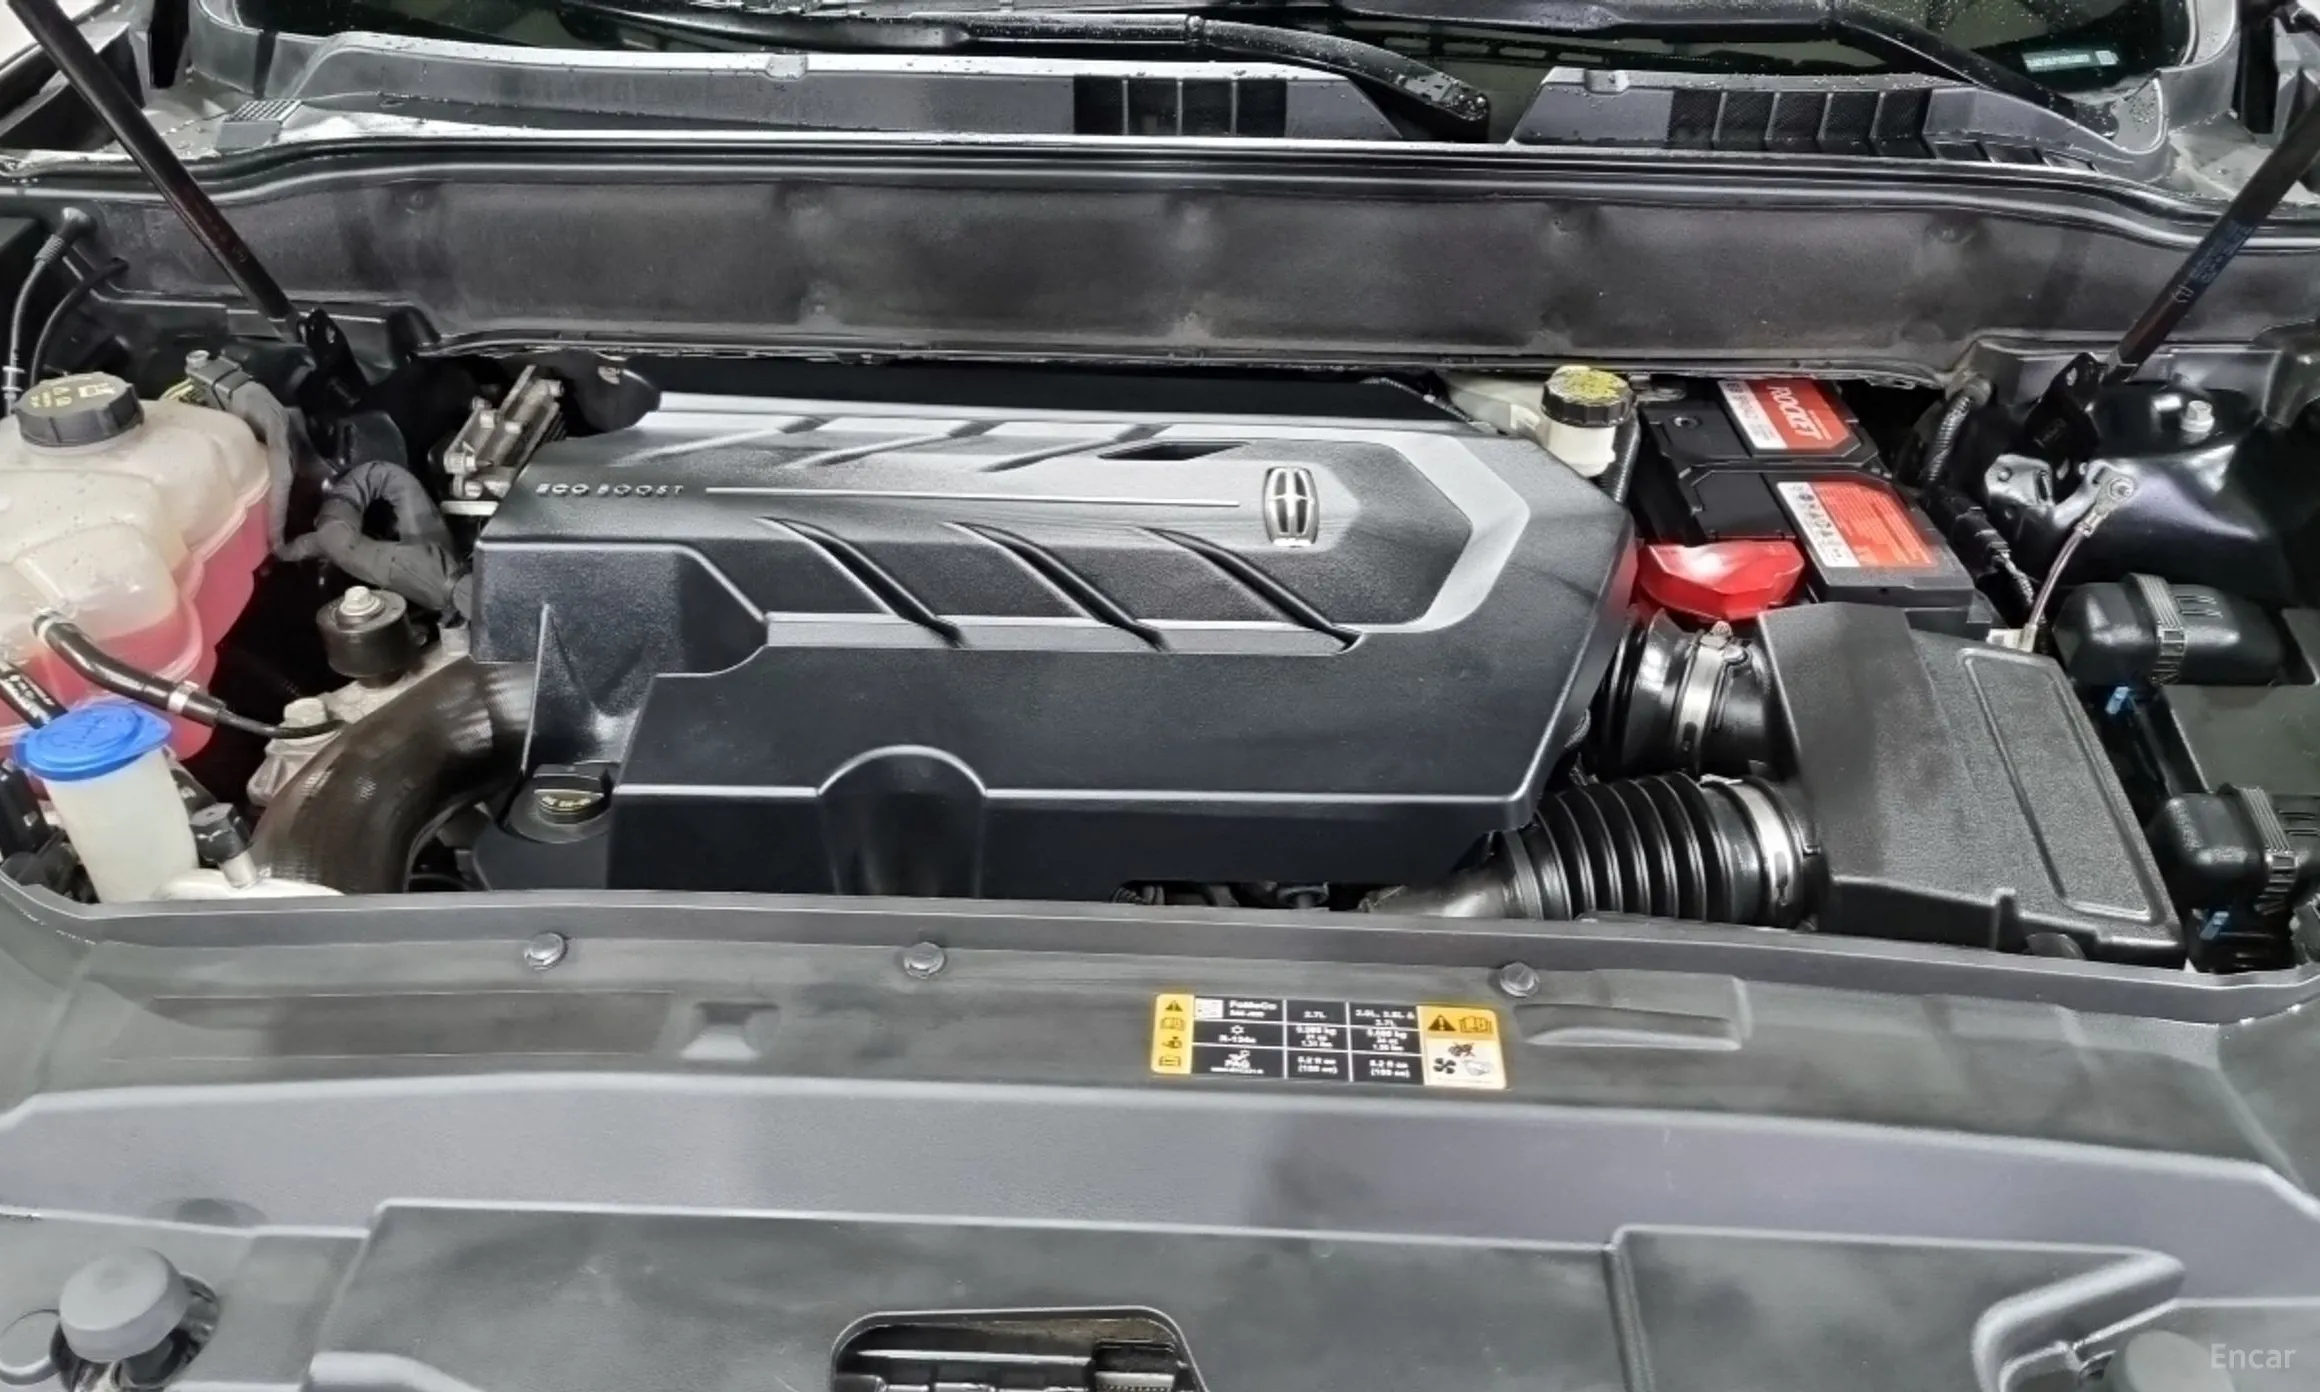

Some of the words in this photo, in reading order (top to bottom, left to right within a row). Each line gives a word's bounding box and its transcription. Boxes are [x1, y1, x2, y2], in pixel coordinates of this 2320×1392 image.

[1766, 385, 1824, 440] ROCKET
[535, 483, 590, 496] ECO
[597, 483, 684, 497] BOOST
